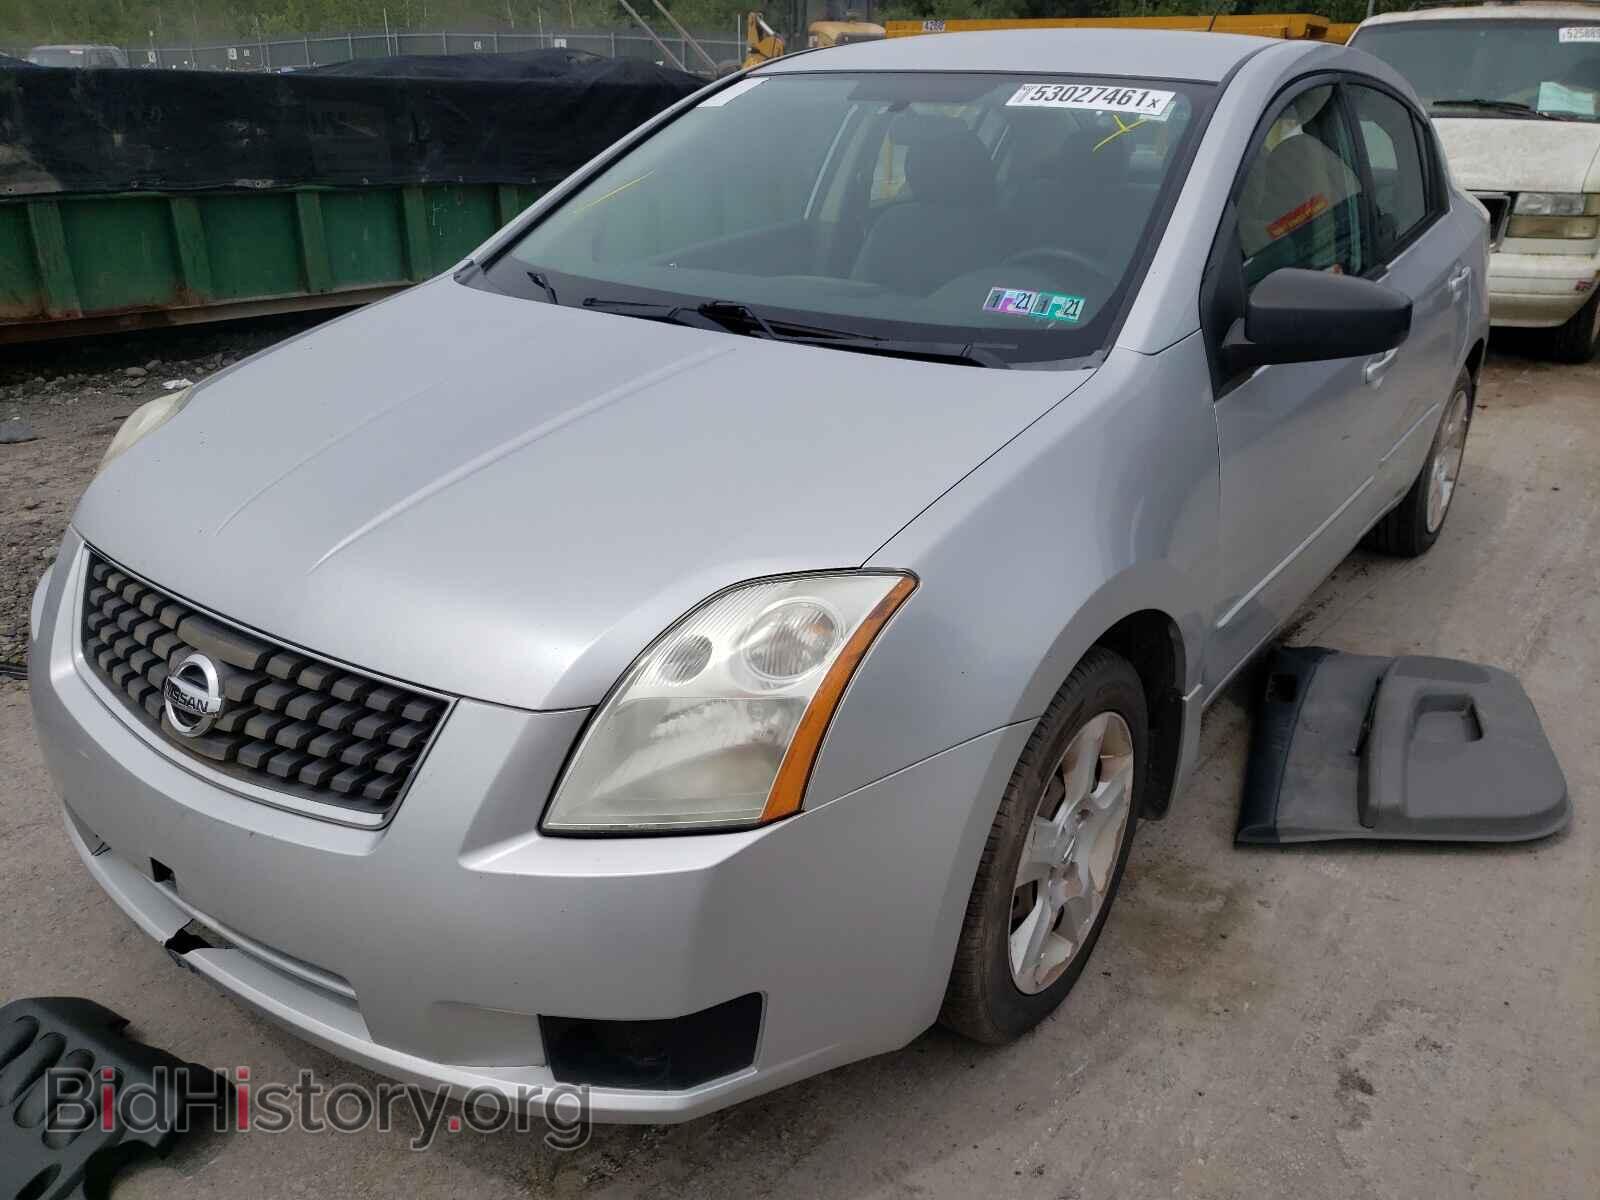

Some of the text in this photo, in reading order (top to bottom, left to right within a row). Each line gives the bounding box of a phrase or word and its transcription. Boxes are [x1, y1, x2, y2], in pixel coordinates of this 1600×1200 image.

[1030, 85, 1149, 107] 53027461
[1015, 292, 1033, 310] 21
[1063, 299, 1081, 317] 21
[165, 679, 209, 713] NISSAN
